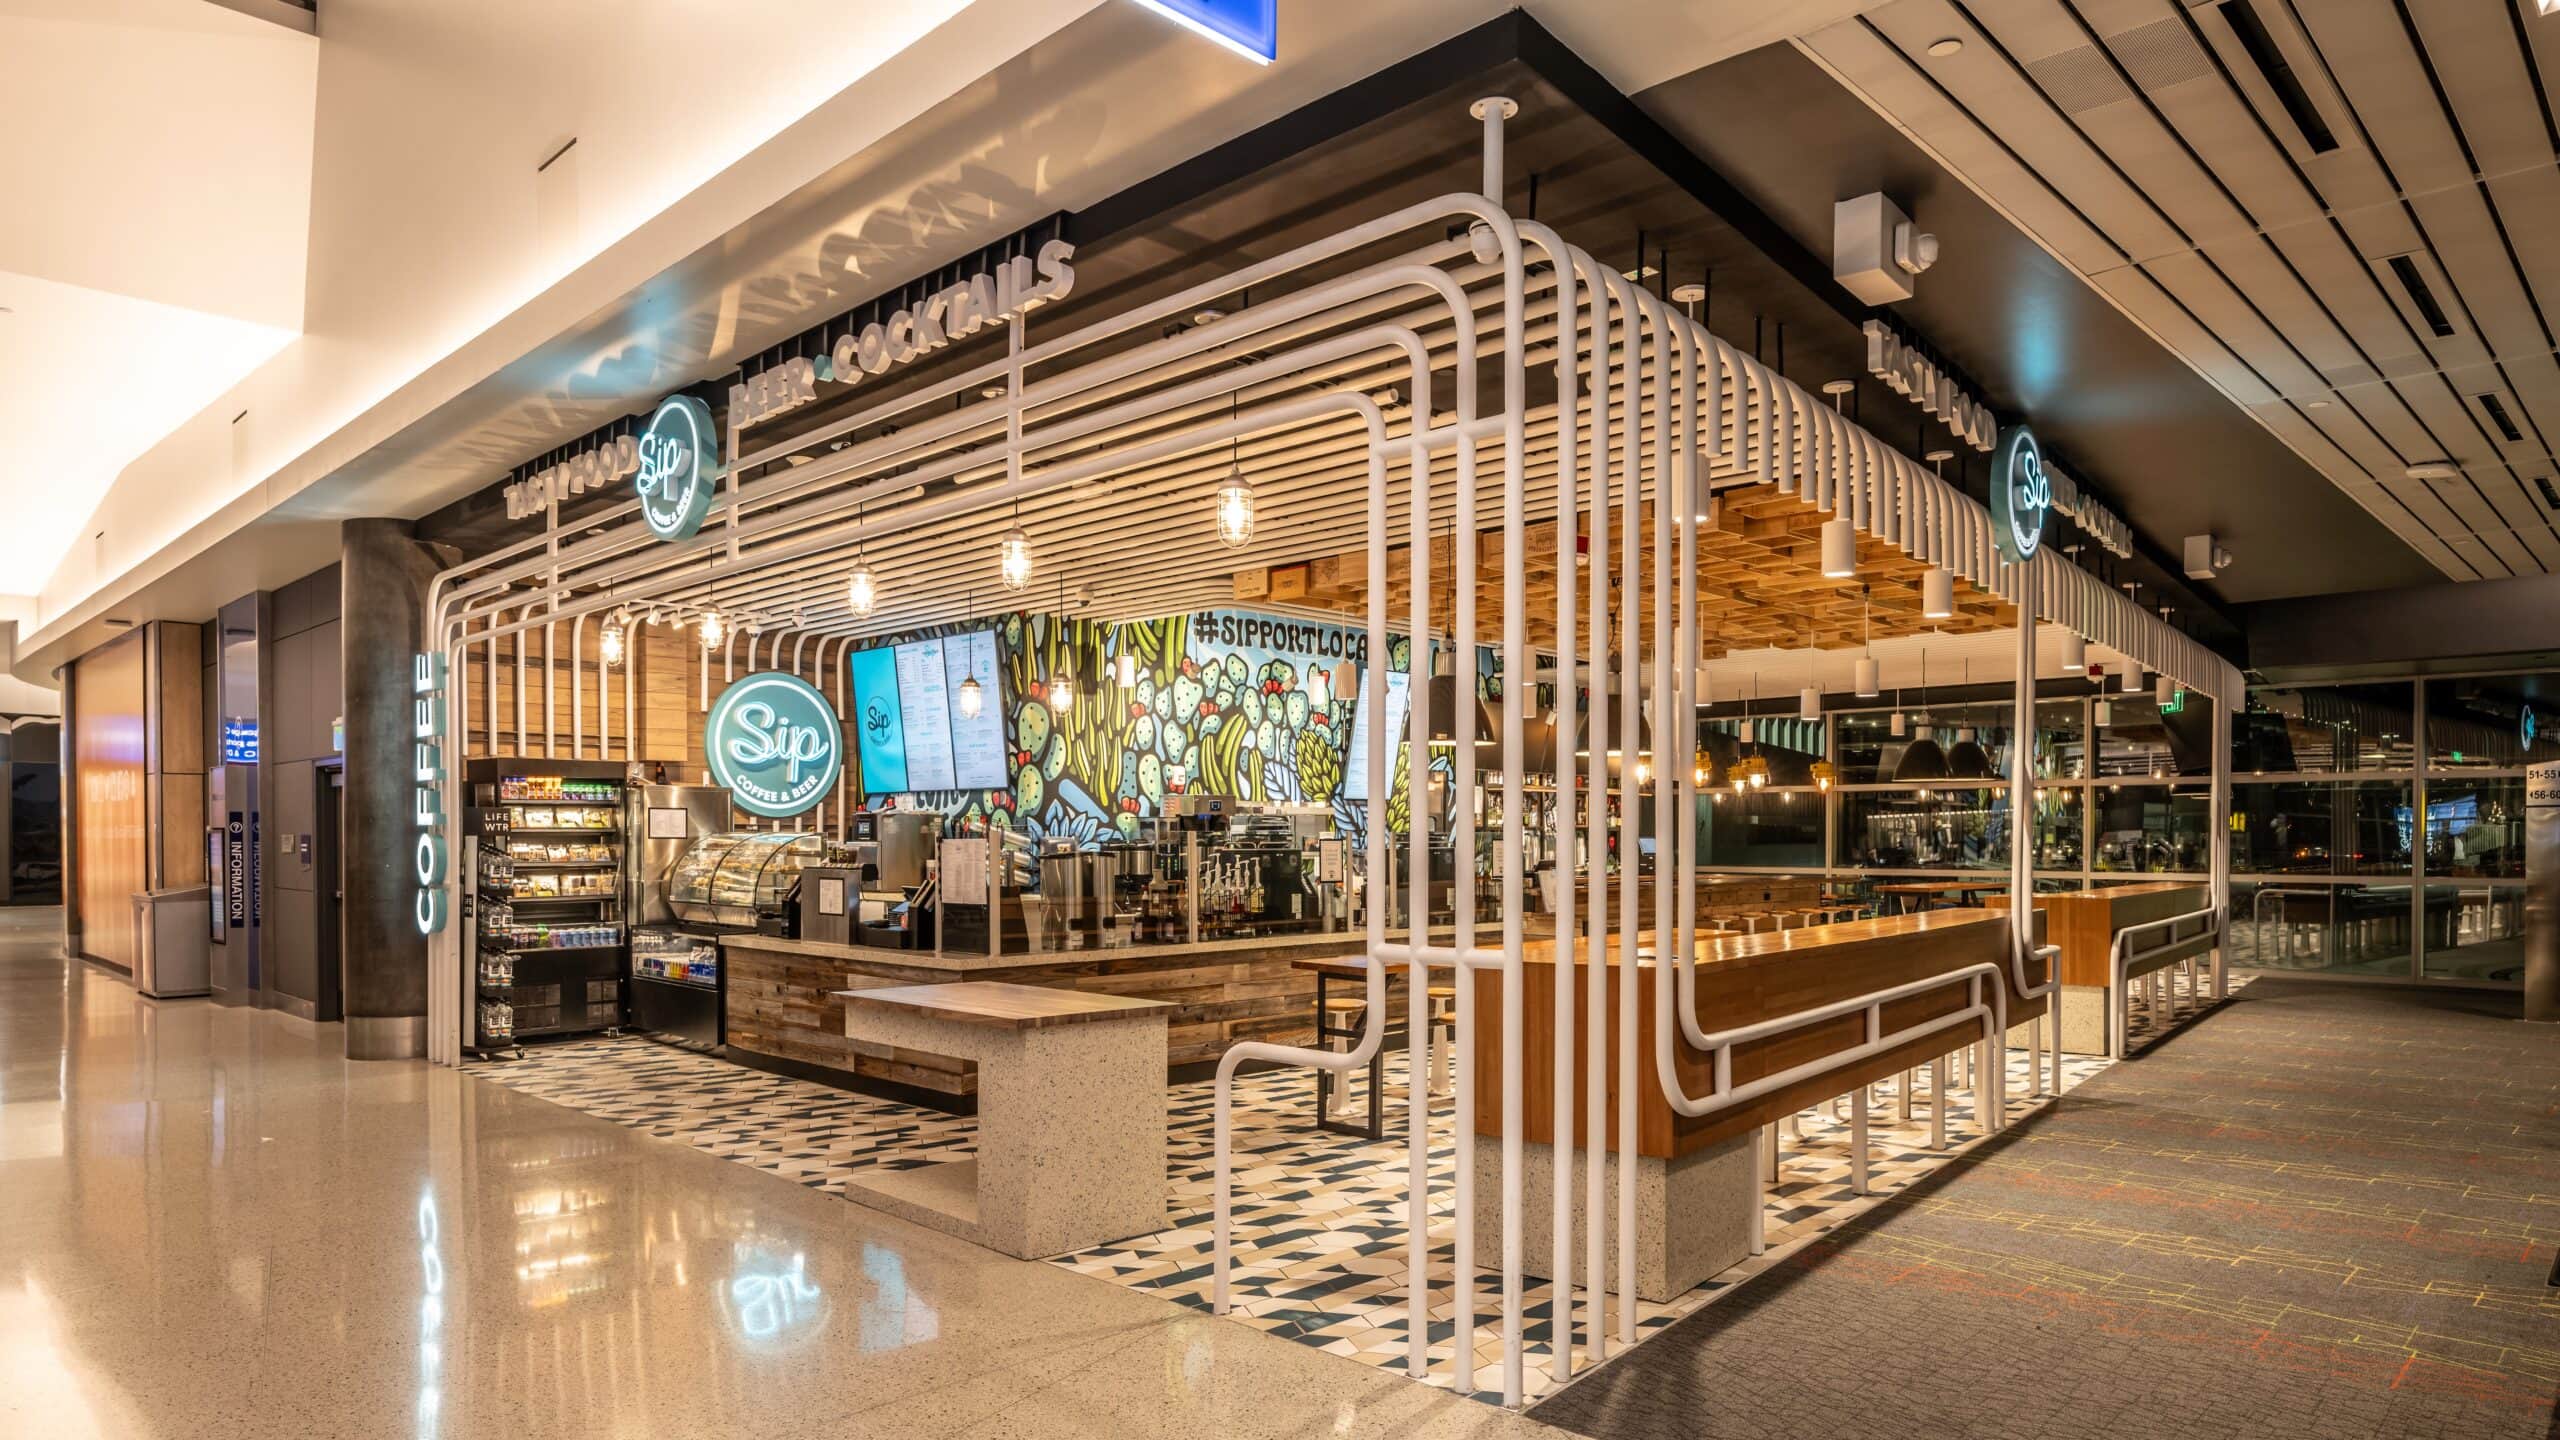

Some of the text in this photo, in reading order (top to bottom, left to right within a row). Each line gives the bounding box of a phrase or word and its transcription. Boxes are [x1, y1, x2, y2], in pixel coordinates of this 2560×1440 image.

[729, 239, 1075, 430] BEER COCKTAILS
[637, 431, 684, 500] Sip
[2023, 451, 2050, 529] Sip
[1194, 611, 1369, 662] #SIPPORTLOCA
[728, 701, 829, 784] Sip
[868, 705, 891, 738] Sip
[416, 653, 440, 934] COFFEE
[736, 774, 818, 802] COFFEE & BEER
[2529, 770, 2557, 780] 51-55
[485, 812, 509, 821] LIFE
[485, 823, 509, 832] WTR
[231, 841, 243, 920] INFORMATION
